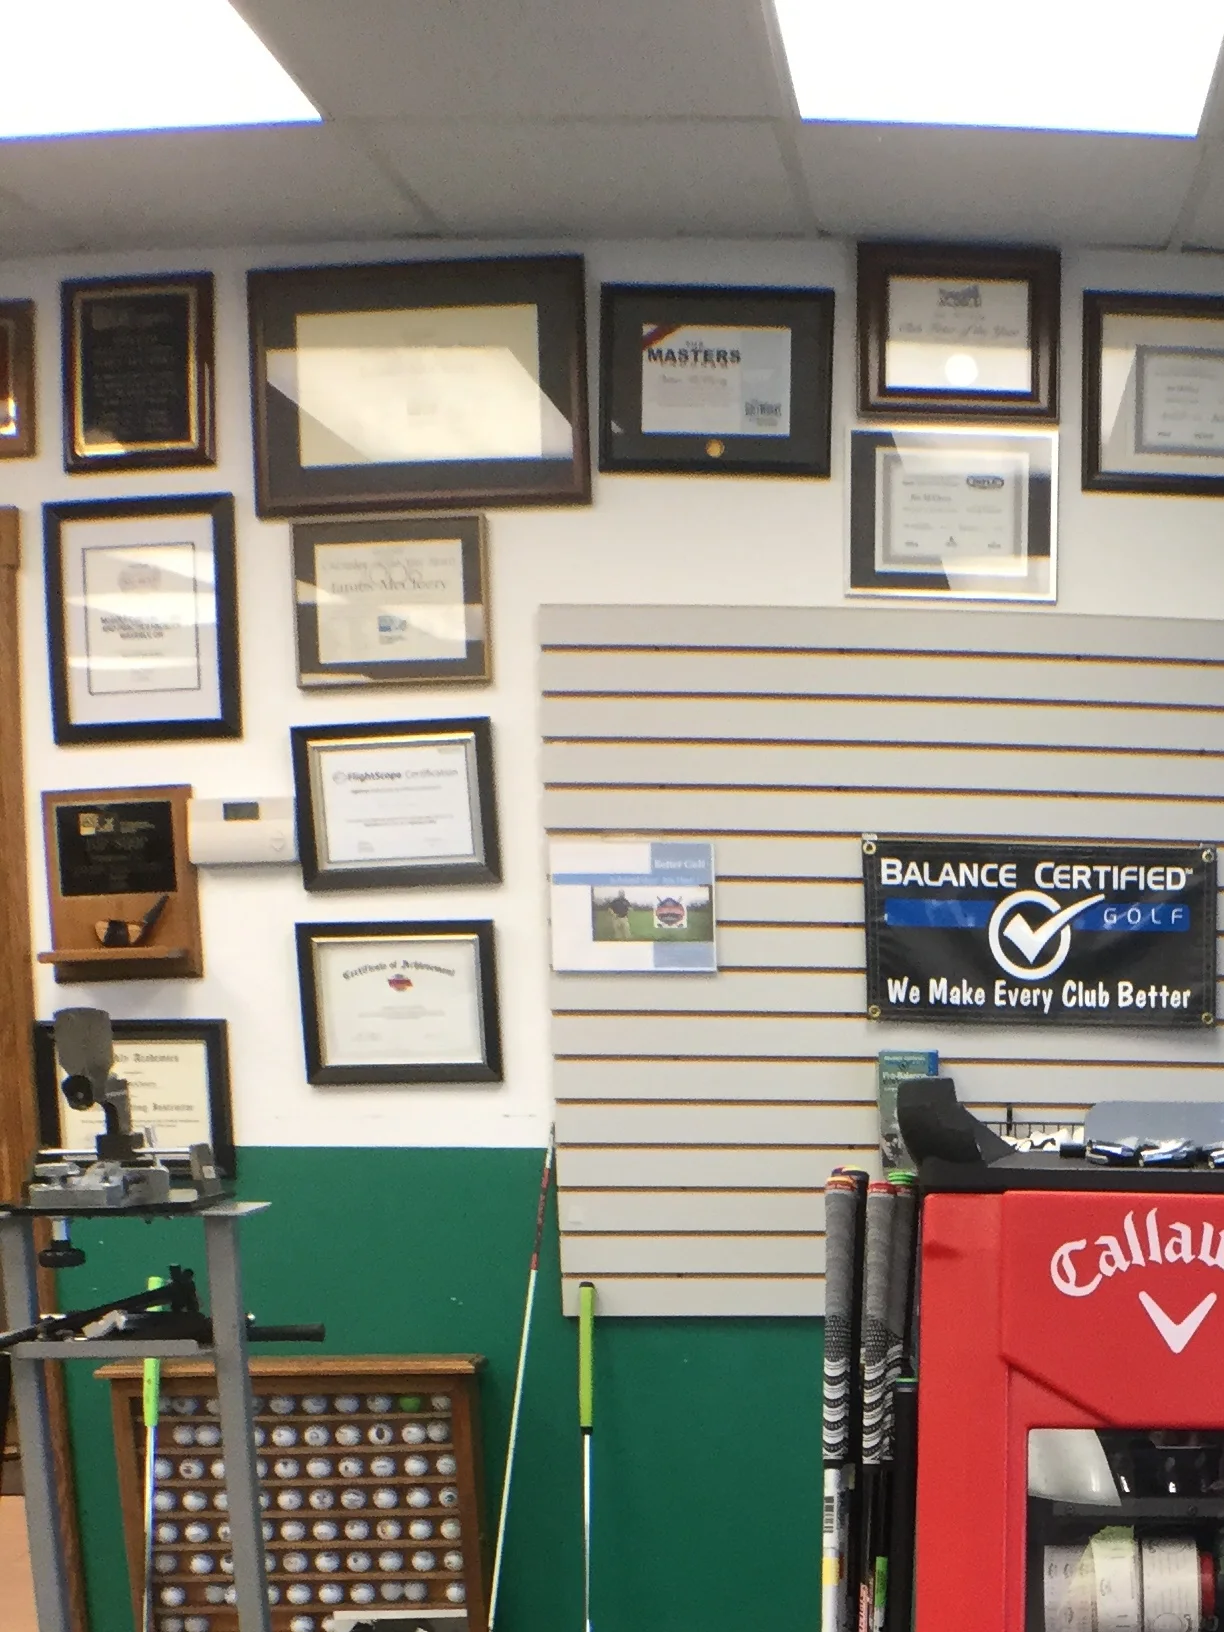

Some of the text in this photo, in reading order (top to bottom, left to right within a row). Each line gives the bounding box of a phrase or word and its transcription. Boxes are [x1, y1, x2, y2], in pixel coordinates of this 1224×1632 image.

[647, 348, 742, 364] MASTERS
[347, 767, 459, 783] FlightScope Certification
[880, 857, 1188, 891] BALANCE CERTIFIED
[1103, 907, 1184, 925] GOLF
[401, 959, 456, 977] Achievement
[887, 977, 1192, 1014] We Make Every Club Better
